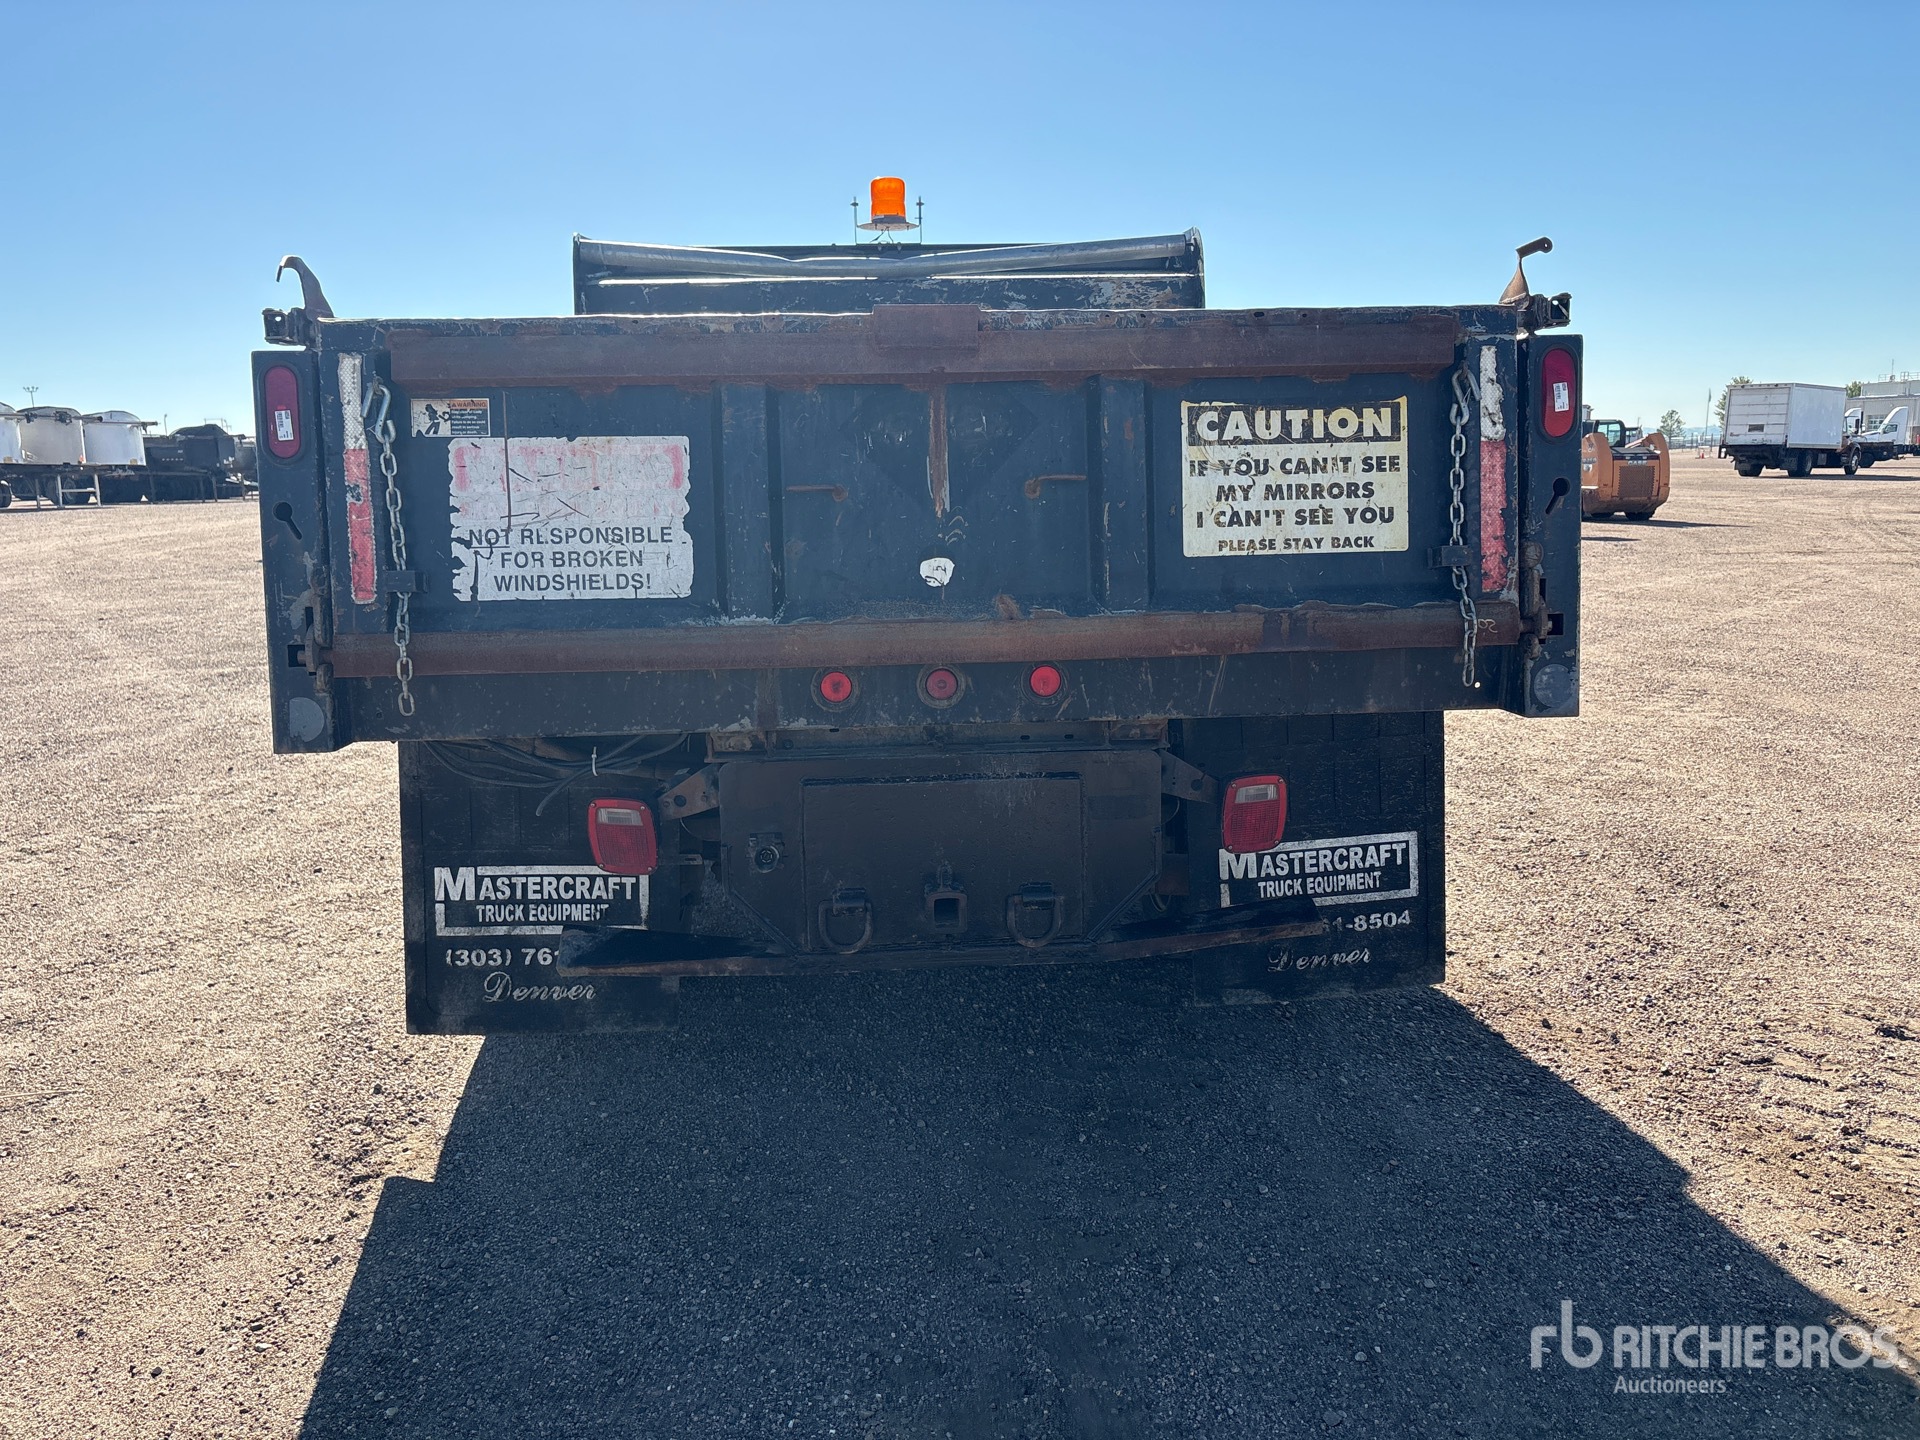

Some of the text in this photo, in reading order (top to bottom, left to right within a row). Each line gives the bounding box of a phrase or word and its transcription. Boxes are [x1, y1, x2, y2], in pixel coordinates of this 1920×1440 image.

[1196, 407, 1392, 441] CAUTION
[1189, 459, 1209, 477] IF
[1218, 458, 1269, 477] YOU
[1361, 455, 1401, 473] SEE
[1216, 481, 1375, 502] MY MIRRORS
[1196, 505, 1395, 528] I CAN'T SEE YOU
[469, 526, 673, 545] NOT RESPONSIBLE
[1218, 535, 1375, 552] PLEASE STAY BACK
[500, 550, 643, 569] FOR BROKEN
[493, 572, 651, 592] WINDSHIELDS!
[1257, 871, 1381, 899] TRUCK EQUIPMENT
[476, 903, 609, 923] TRUCK EQUIPMENT
[445, 947, 560, 967] (303) 76
[483, 971, 597, 1003] Denver
